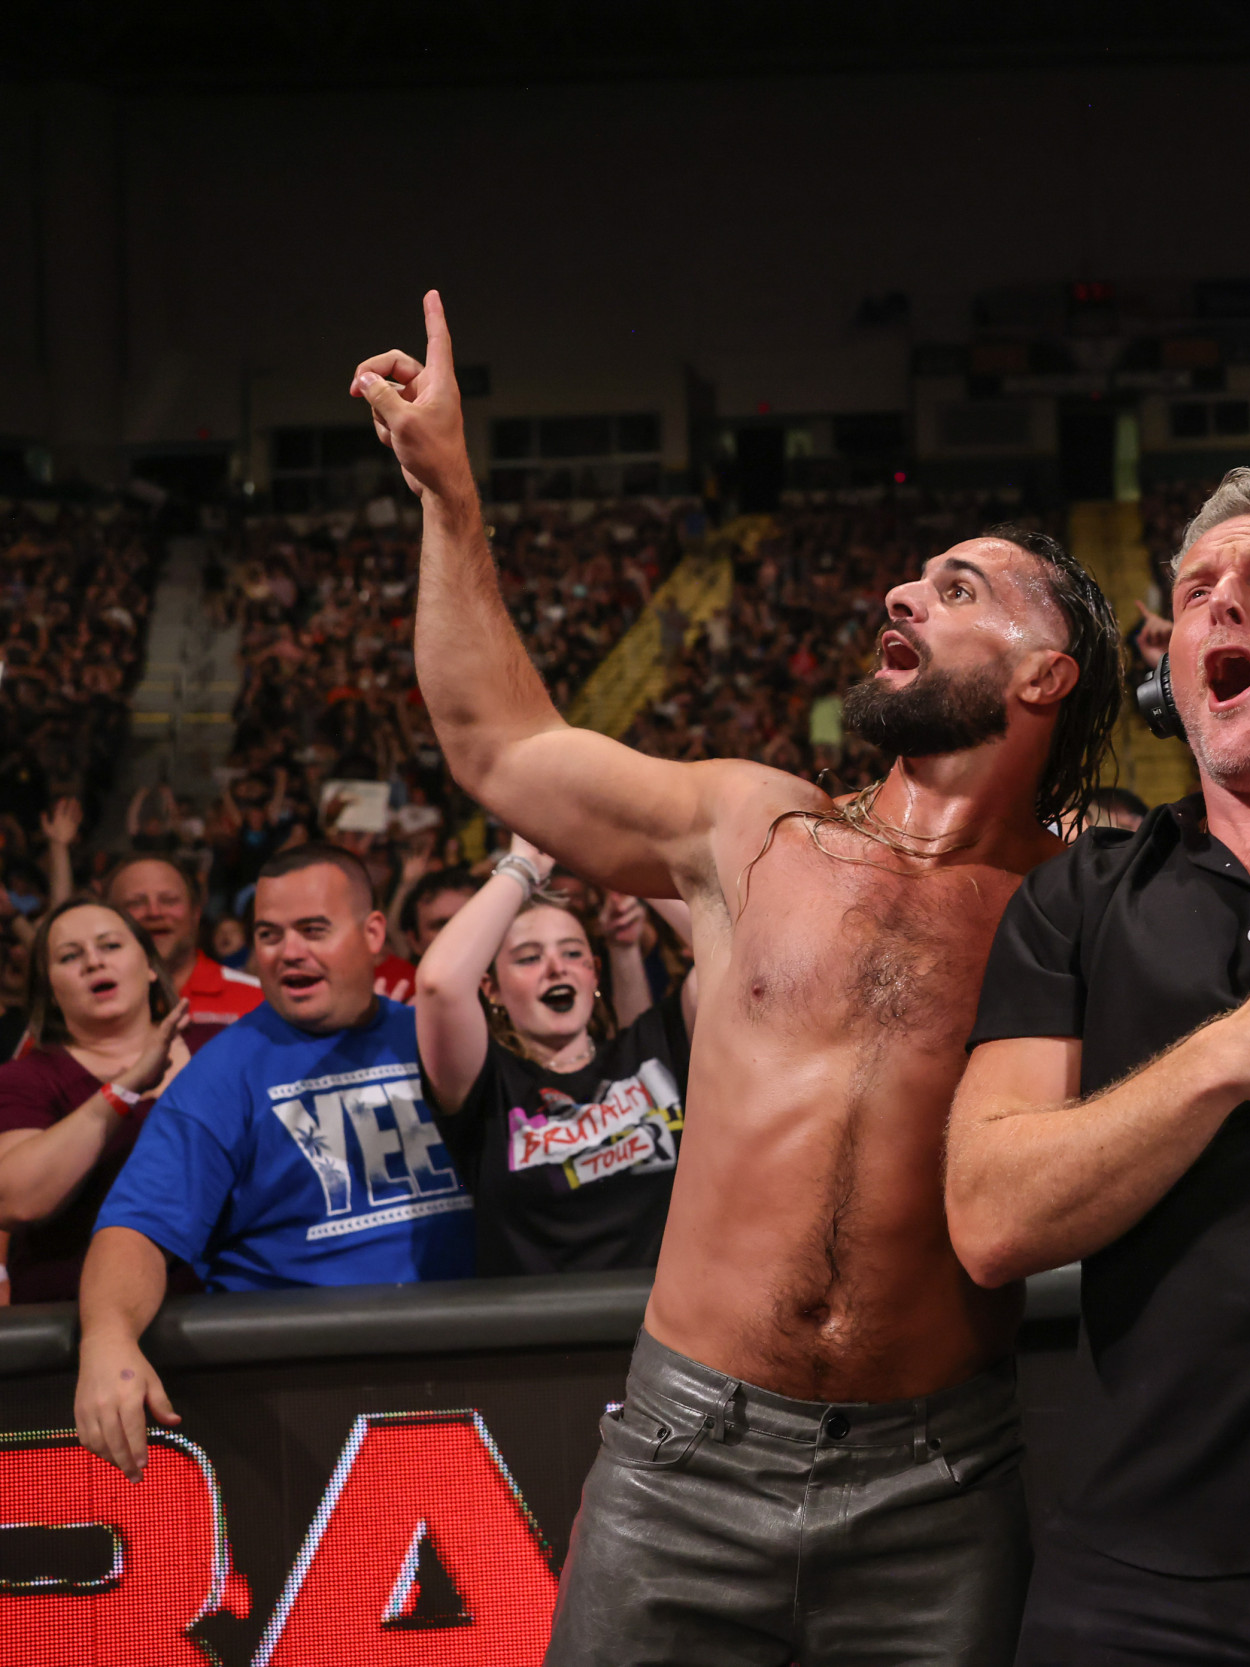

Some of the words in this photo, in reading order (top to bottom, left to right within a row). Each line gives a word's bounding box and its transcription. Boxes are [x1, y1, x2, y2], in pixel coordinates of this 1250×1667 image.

[272, 1079, 458, 1217] YEE
[520, 1081, 654, 1164] BRUTALITY
[580, 1136, 650, 1174] TOUR
[0, 1410, 562, 1667] RA
